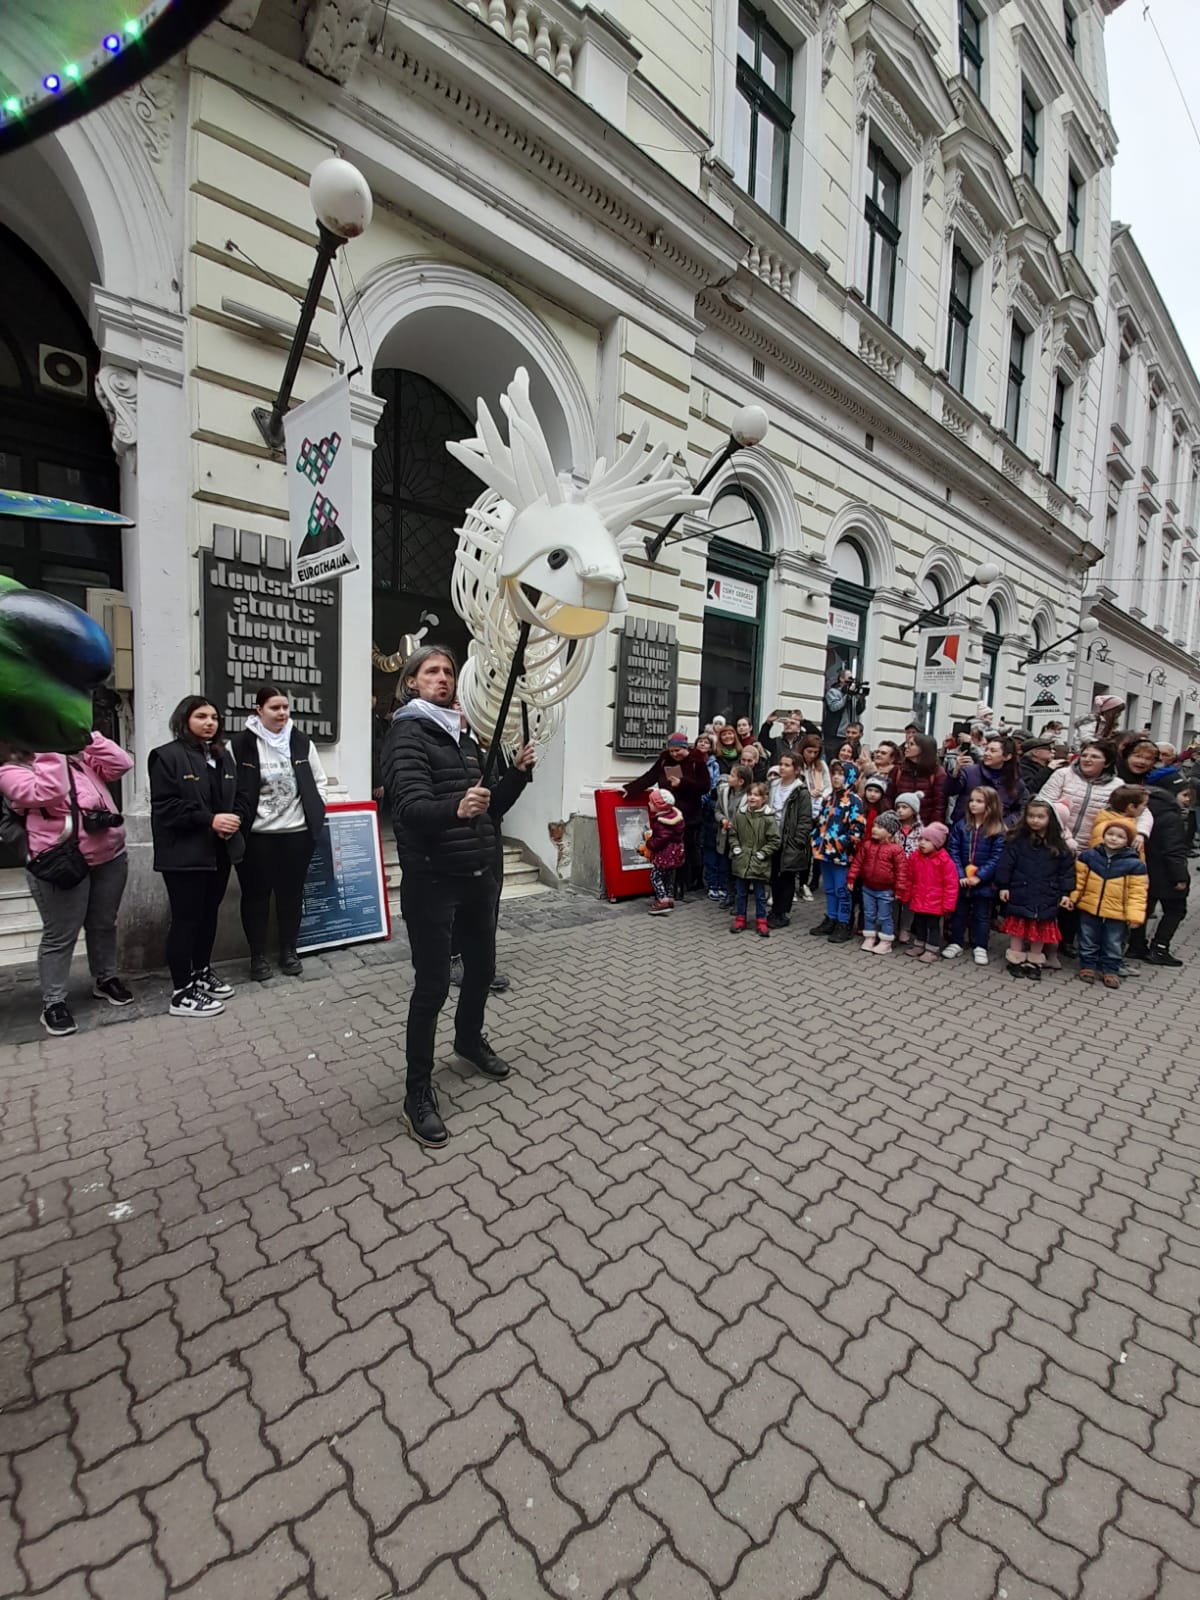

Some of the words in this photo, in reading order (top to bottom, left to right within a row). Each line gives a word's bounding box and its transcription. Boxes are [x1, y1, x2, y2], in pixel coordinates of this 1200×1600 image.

[297, 552, 351, 582] EUROTHALIA
[233, 592, 315, 624] staats
[227, 611, 321, 646] theater
[226, 661, 322, 684] german
[227, 685, 257, 710] de
[287, 689, 322, 713] tat
[626, 719, 641, 733] de
[646, 720, 668, 735] stat
